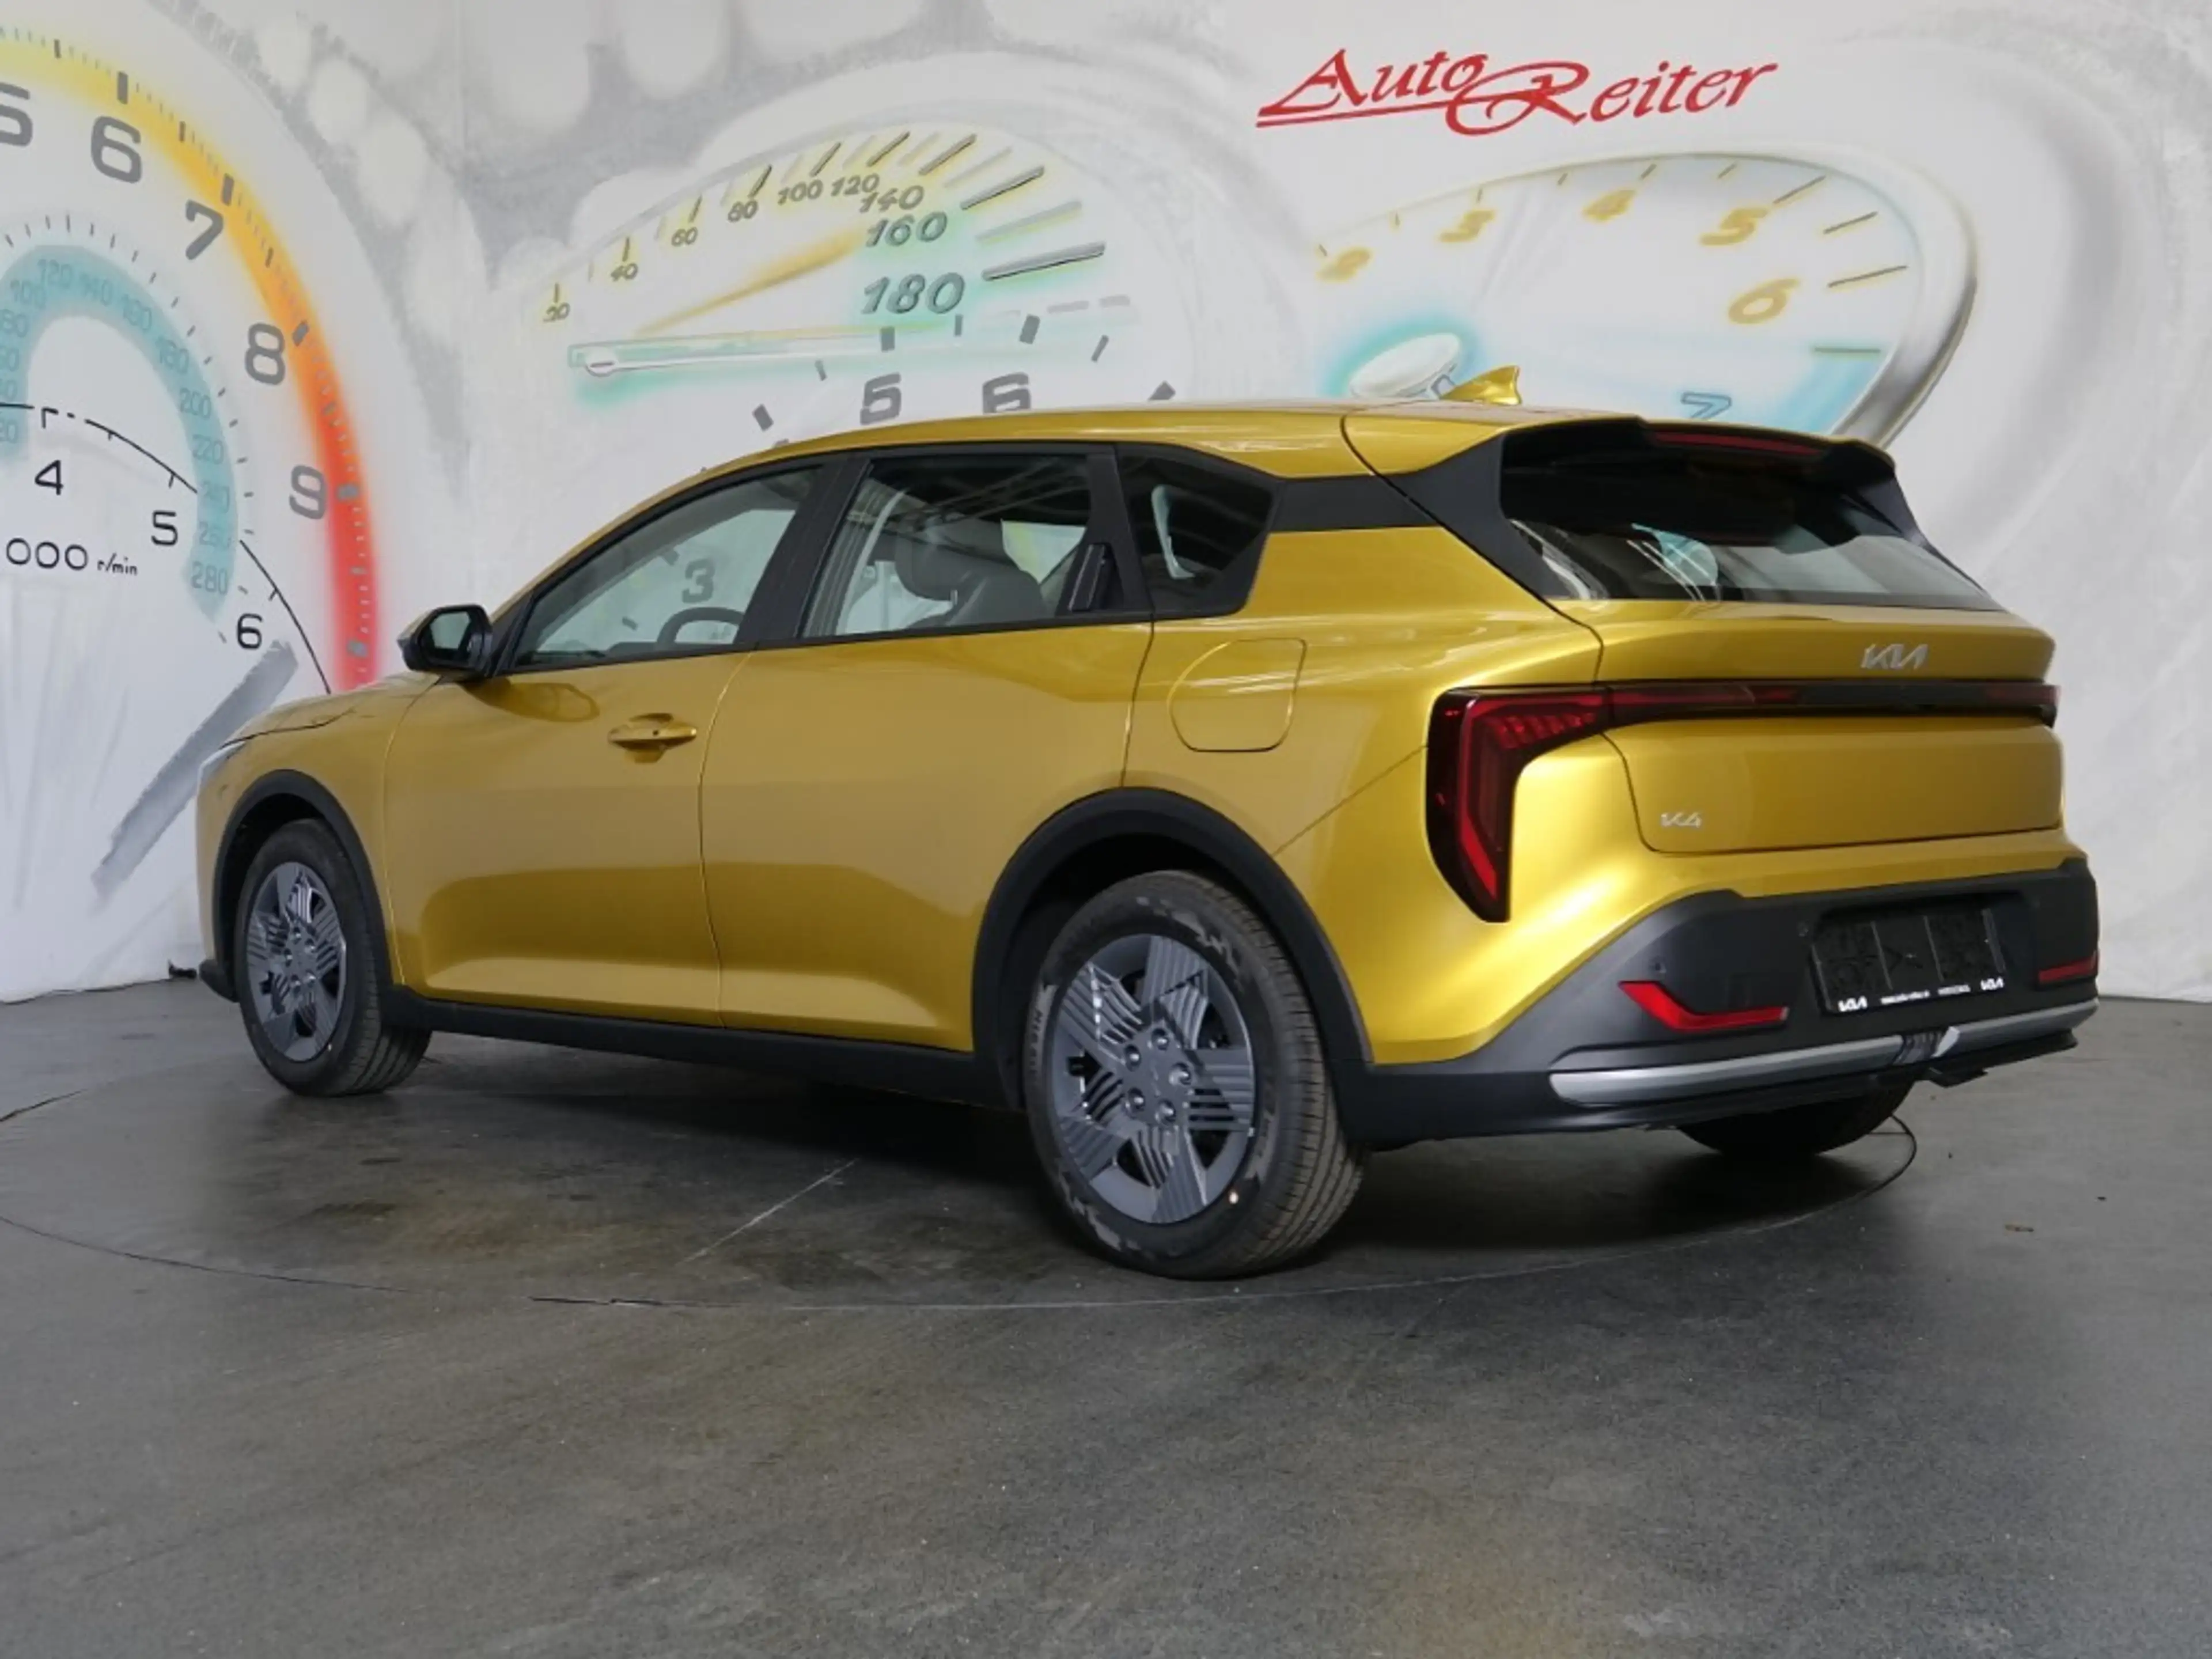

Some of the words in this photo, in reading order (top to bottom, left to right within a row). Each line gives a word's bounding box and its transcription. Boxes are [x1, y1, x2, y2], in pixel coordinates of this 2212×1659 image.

[1257, 49, 1488, 111] Auto
[1446, 60, 1778, 136] Reiter
[91, 116, 142, 184] 6
[778, 180, 823, 206] 100
[830, 174, 880, 196] 120
[859, 185, 924, 213] 140
[728, 200, 759, 222] 80
[866, 211, 948, 247] 160
[1700, 207, 1769, 246] 5
[185, 199, 224, 260] 7
[672, 227, 698, 247] 60
[611, 263, 639, 282] 40
[862, 272, 965, 315] 180
[1728, 278, 1801, 325] 6
[245, 322, 286, 385] 8
[860, 373, 902, 425] 5
[35, 460, 64, 495] 4
[289, 464, 327, 520] 9
[151, 510, 179, 546] 5
[97, 552, 138, 576] r/min
[191, 560, 229, 596] 280
[681, 558, 715, 604] 3
[236, 613, 263, 650] 6
[1861, 643, 1929, 671] KIA
[1660, 812, 1703, 828] K4
